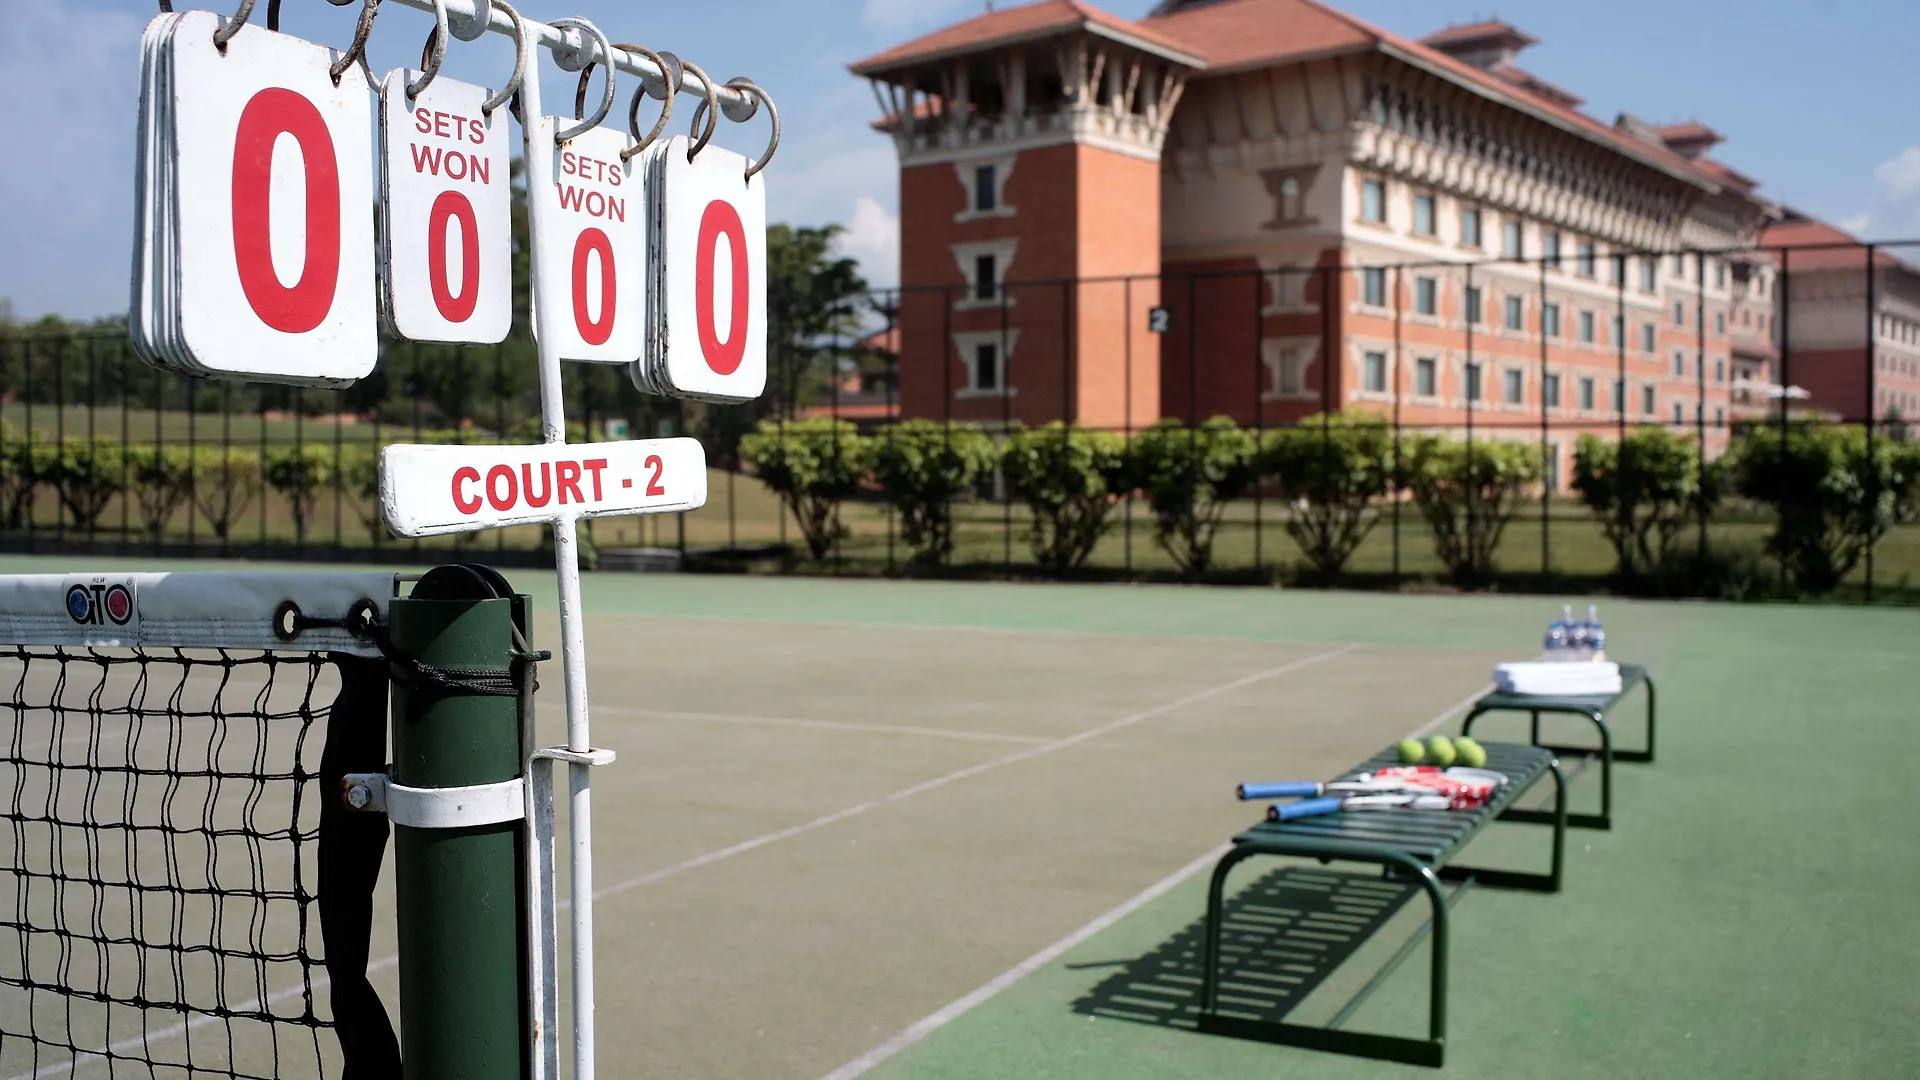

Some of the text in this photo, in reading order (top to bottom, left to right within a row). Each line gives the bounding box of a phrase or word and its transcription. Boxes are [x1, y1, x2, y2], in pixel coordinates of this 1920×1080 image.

[414, 107, 485, 145] SETS
[410, 143, 490, 185] WON
[562, 151, 622, 187] SETS
[231, 86, 341, 334] 0
[557, 183, 626, 223] WON
[427, 189, 480, 324] 0
[571, 227, 617, 346] 0
[695, 199, 750, 376] 0
[1151, 308, 1169, 332] 2
[451, 459, 608, 515] COURT
[644, 454, 665, 497] 2
